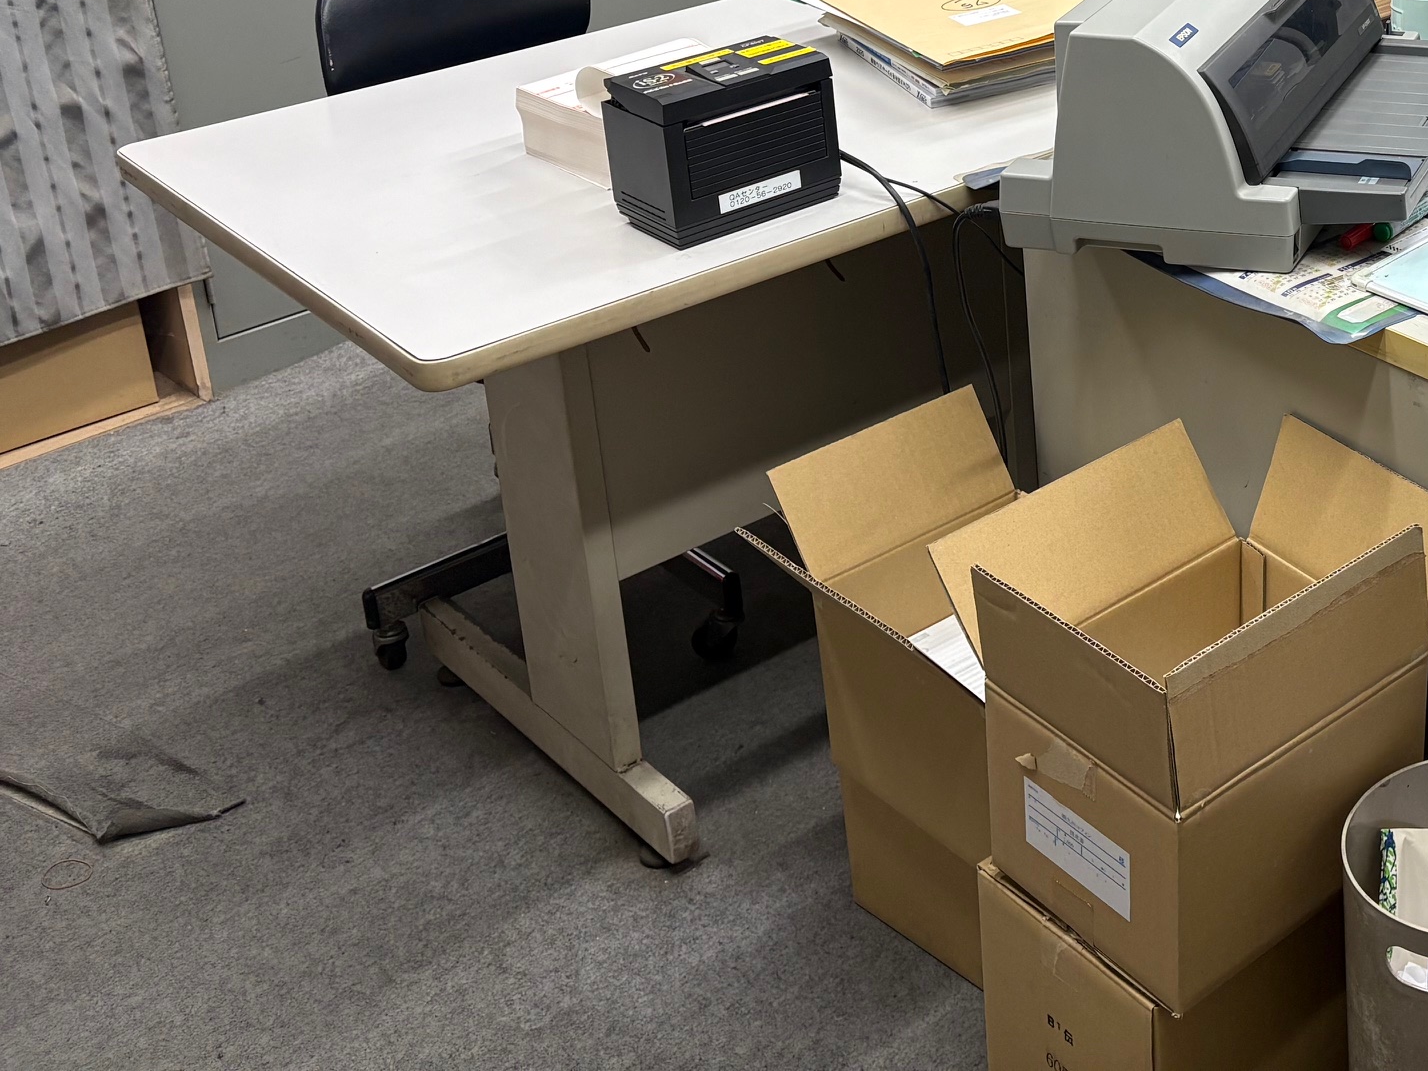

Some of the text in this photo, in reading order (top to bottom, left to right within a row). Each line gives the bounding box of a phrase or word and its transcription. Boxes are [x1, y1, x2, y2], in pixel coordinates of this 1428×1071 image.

[1175, 26, 1193, 43] EPSON
[729, 185, 768, 202] QAセンター
[729, 181, 792, 208] 0120-56-2920
